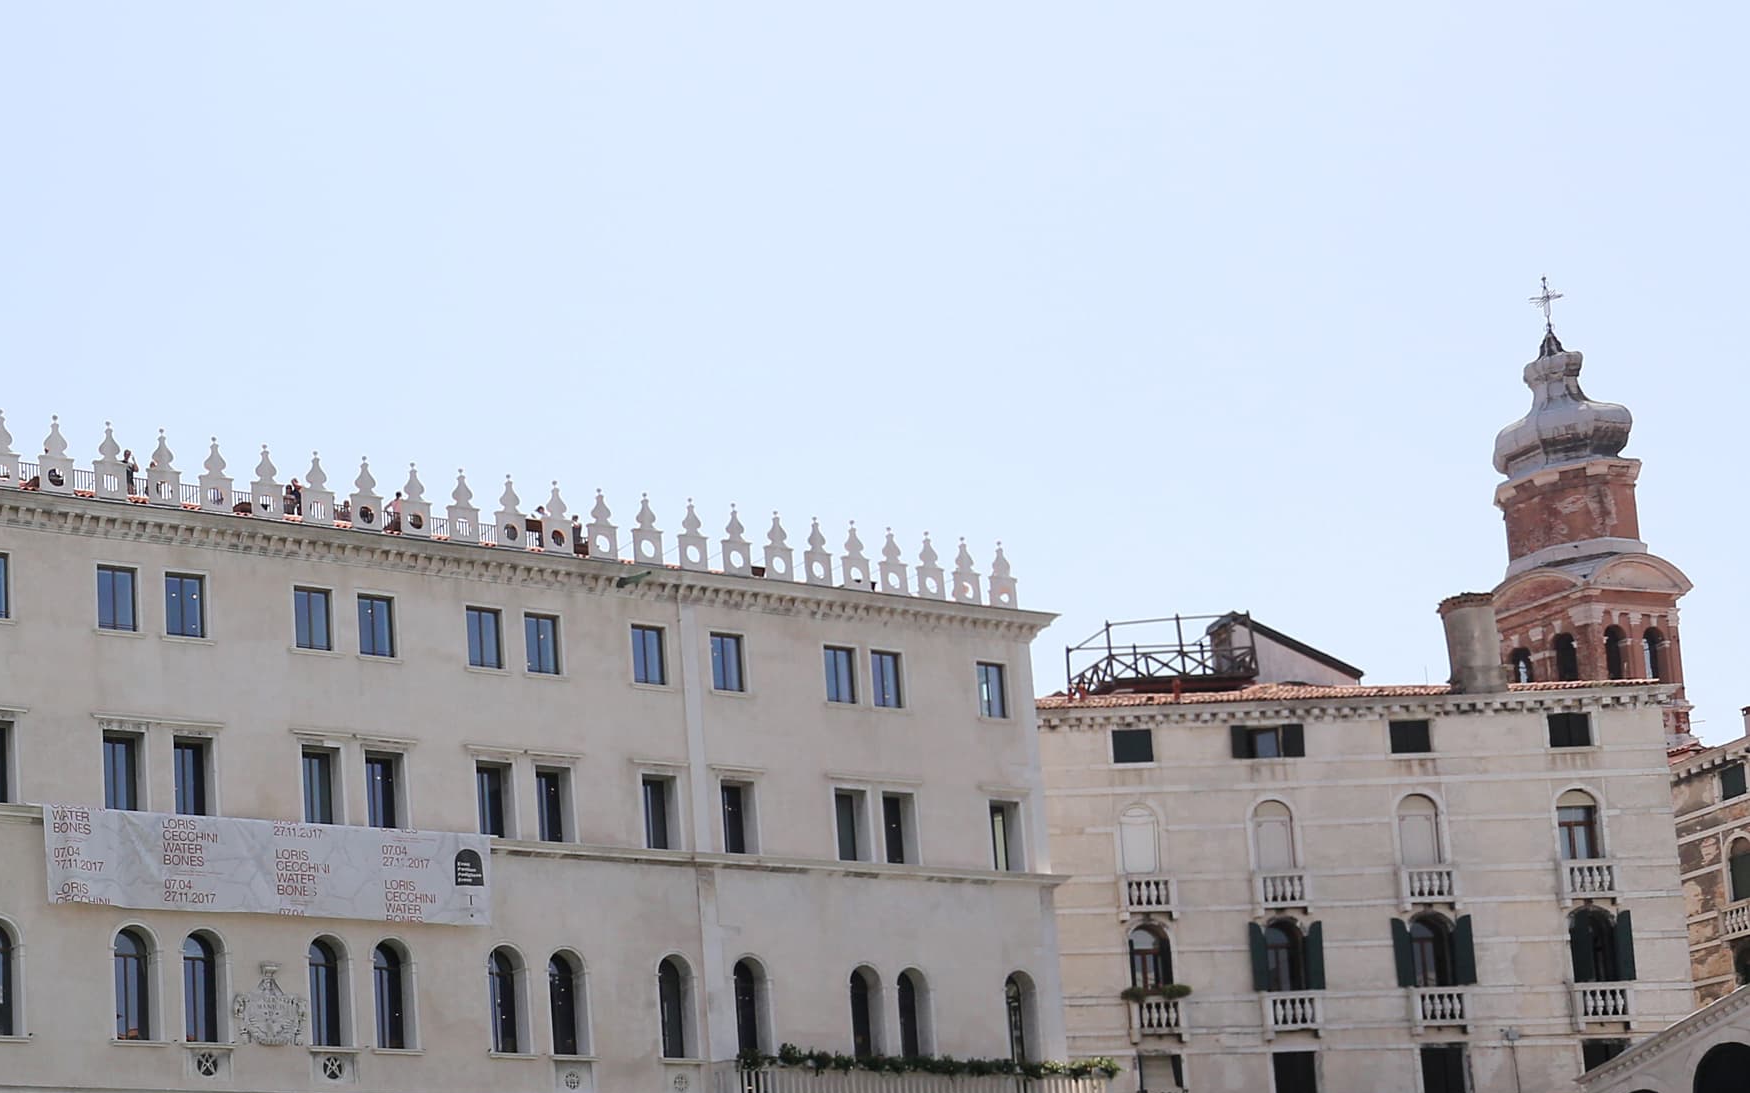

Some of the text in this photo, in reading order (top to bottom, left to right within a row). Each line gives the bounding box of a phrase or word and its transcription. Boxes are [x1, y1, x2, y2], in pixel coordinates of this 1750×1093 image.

[52, 810, 90, 822] WATER
[53, 822, 91, 835] BONES
[162, 819, 196, 830] LORIS
[163, 830, 218, 843] CECCHINI
[54, 846, 80, 858] 07.04
[163, 842, 203, 854] WATER
[382, 845, 407, 856] 07.04
[276, 848, 309, 861] LORIS
[163, 855, 204, 867] BONES
[383, 857, 430, 869] 27.1.2017
[276, 861, 330, 874] CECCHINI
[164, 879, 192, 890] 07.04
[276, 873, 316, 885] WATER
[385, 880, 416, 891] LORIS
[164, 890, 216, 903] 27.11.2017
[386, 891, 436, 904] CECCHINI
[386, 903, 422, 915] WATER
